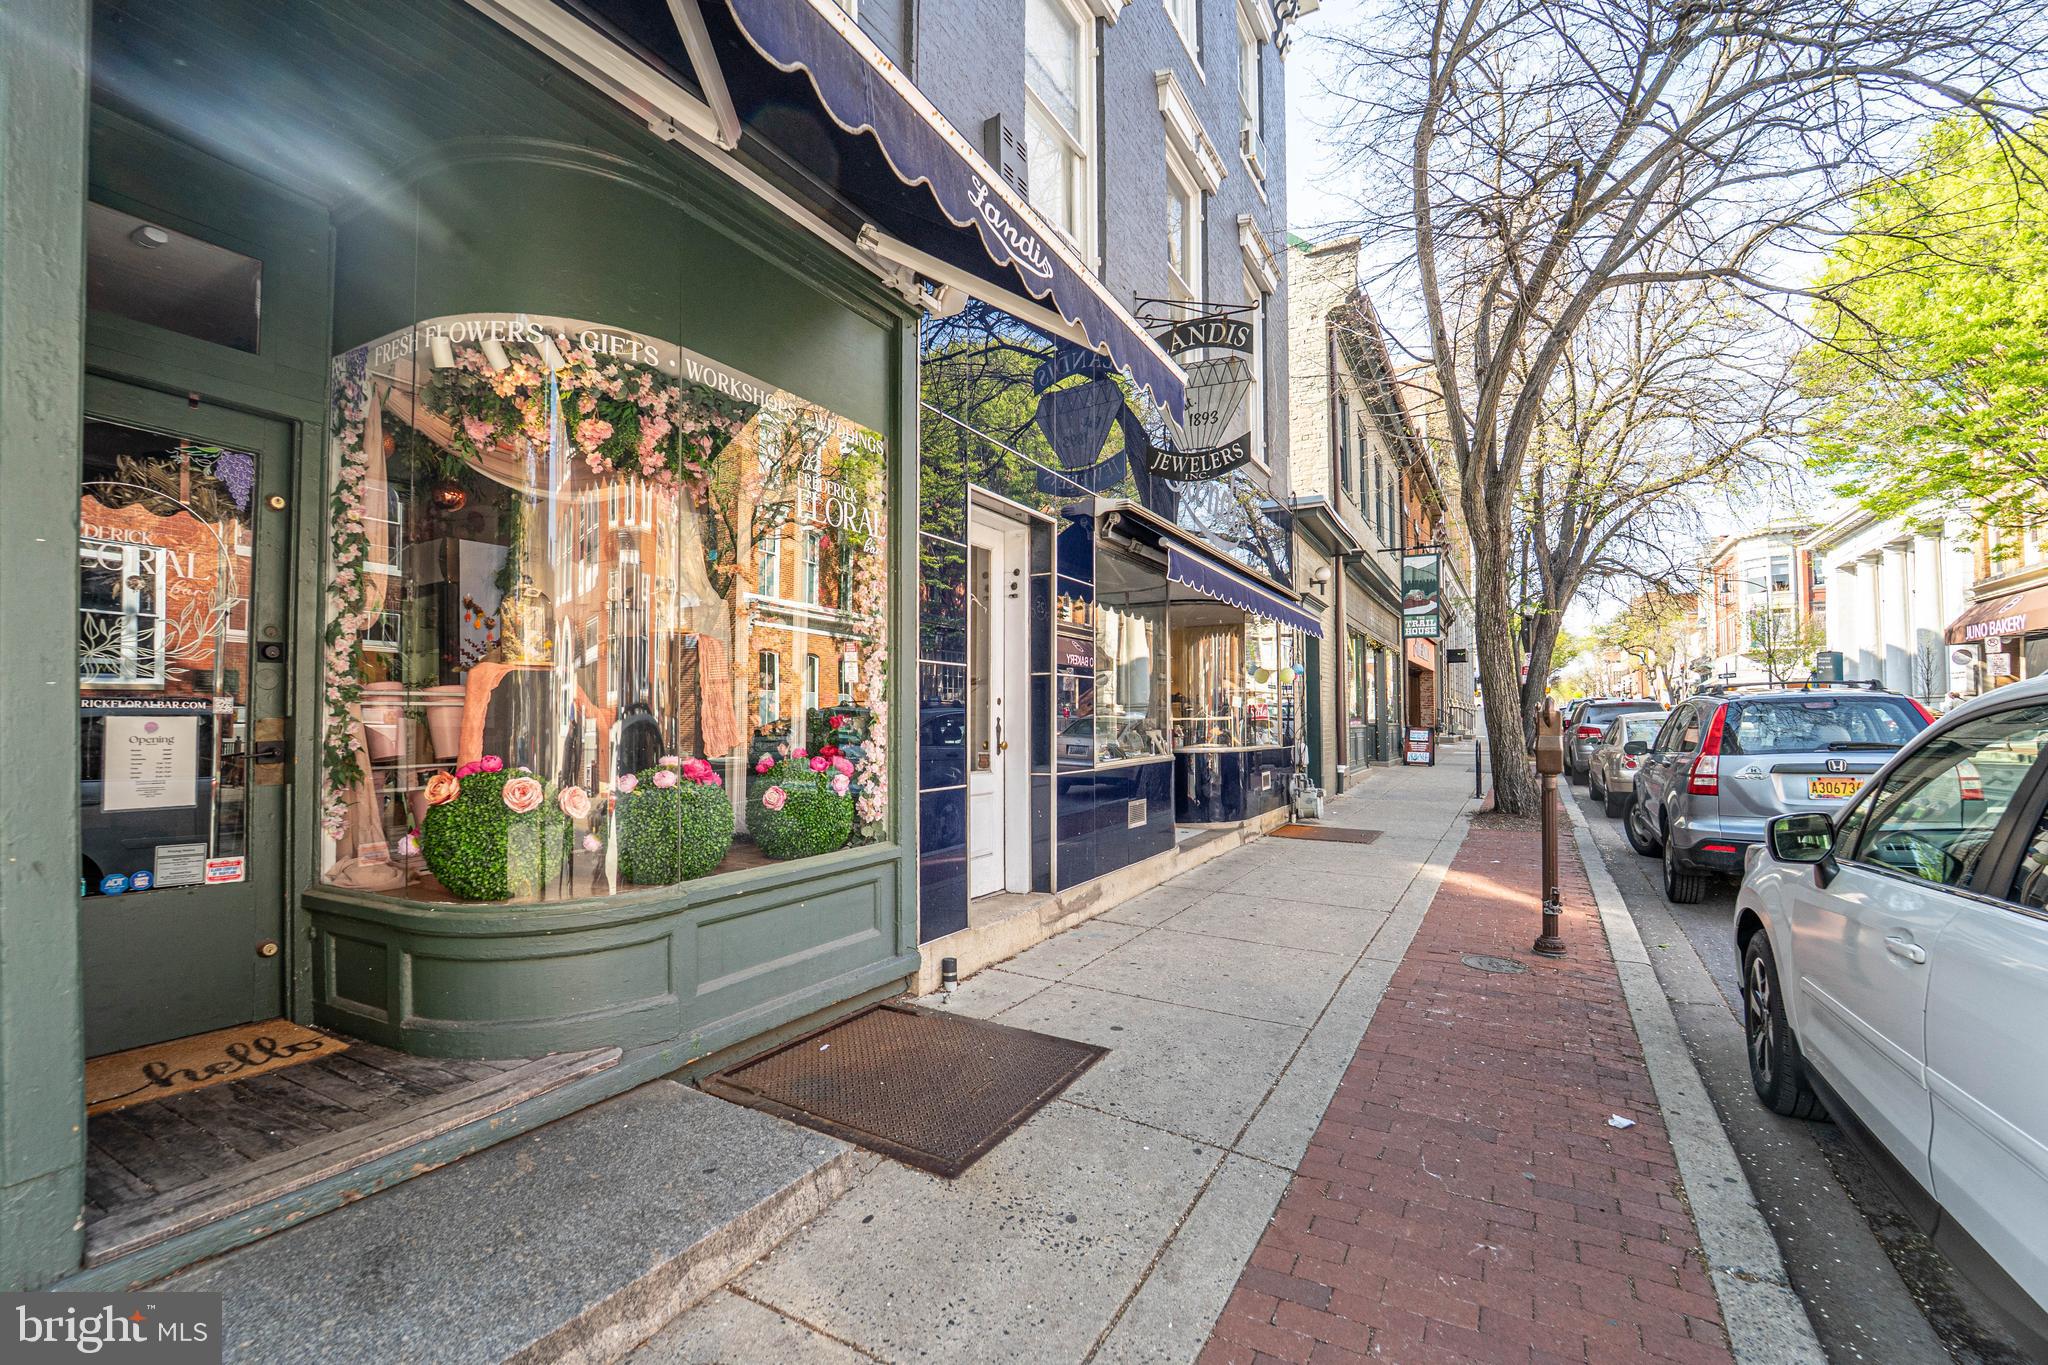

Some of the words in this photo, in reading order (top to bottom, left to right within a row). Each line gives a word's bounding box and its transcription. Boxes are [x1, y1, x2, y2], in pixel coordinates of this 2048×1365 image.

[967, 174, 1054, 278] Landis
[1167, 322, 1250, 353] ANDIS
[375, 331, 419, 366] FRESH
[425, 320, 545, 348] FLOWERS
[580, 330, 659, 367] GIFTS
[685, 358, 798, 420] WORKSHOPS
[814, 412, 885, 456] WEDDINGS
[1189, 410, 1219, 427] 1893
[1151, 442, 1244, 473] JEWELERS
[797, 472, 858, 503] FREDERICK
[1185, 471, 1210, 480] INC.
[797, 486, 886, 540] FLORAL
[80, 521, 154, 545] DERICK
[1404, 619, 1436, 628] TRAIL
[1404, 627, 1437, 636] HOUSE
[1966, 622, 1988, 640] JUNO
[1989, 614, 2027, 635] BAKERY
[128, 735, 175, 746] Opening
[105, 877, 125, 887] ADT
[104, 1035, 325, 1096] hello
